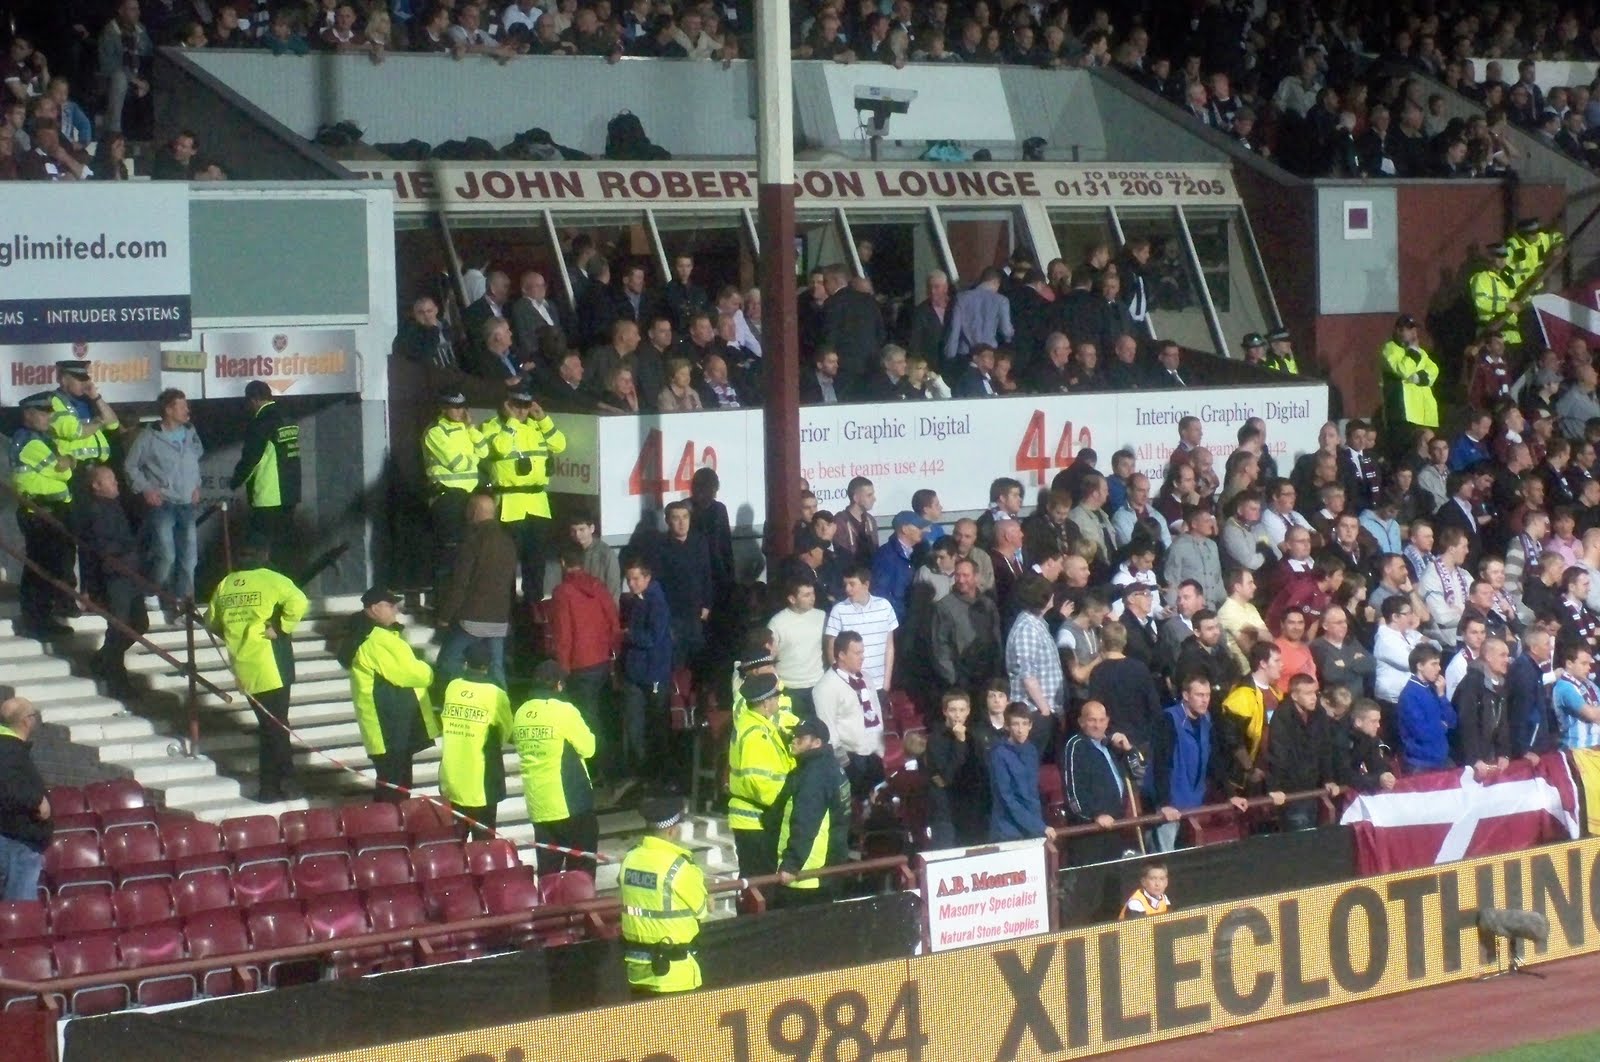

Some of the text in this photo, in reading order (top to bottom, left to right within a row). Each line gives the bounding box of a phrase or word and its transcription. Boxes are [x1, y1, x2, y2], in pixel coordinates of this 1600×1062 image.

[456, 171, 584, 199] JOHN
[876, 170, 1041, 198] LOUNGE
[1082, 171, 1191, 180] TO BOOK CALL
[1055, 179, 1225, 196] 0131 200 7205
[0, 233, 167, 267] glimited.com
[47, 309, 116, 324] INTRUDER
[121, 307, 180, 322] SYSTEMS
[175, 353, 199, 365] EXIT
[1201, 402, 1255, 426] Graphic
[1265, 400, 1310, 424] Digital
[800, 414, 970, 444] rior Graphic Digital
[1136, 442, 1153, 460] All
[1206, 444, 1237, 458] team
[553, 457, 591, 484] king
[819, 462, 847, 480] best
[850, 462, 890, 478] teams
[894, 461, 916, 474] use
[919, 459, 945, 477] 442
[240, 594, 259, 605] STAFF
[443, 705, 485, 720] EVENT STAFF
[531, 726, 549, 739] STAFF
[626, 872, 657, 888] POLICE
[936, 876, 969, 897] A.B.
[971, 870, 1026, 892] Mearns
[939, 890, 1037, 920] Masonry Specialist
[940, 918, 1039, 945] Natural Stone Supplies
[990, 847, 1600, 1062] XILECLOTHIN
[718, 979, 929, 1062] 1984
